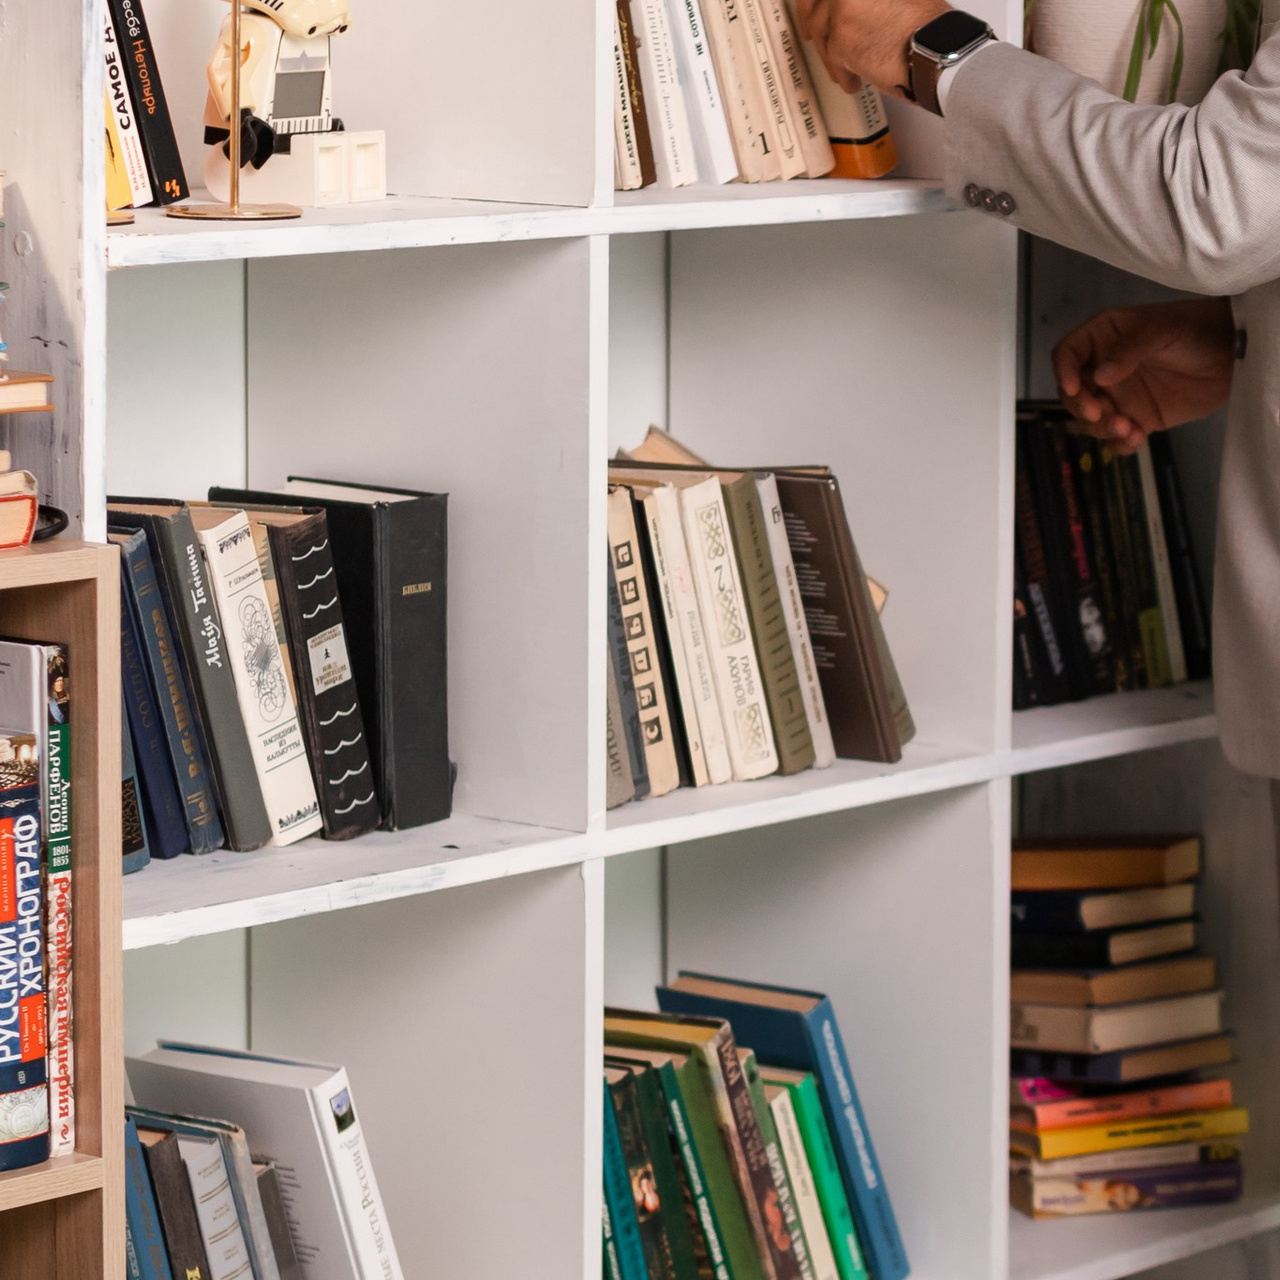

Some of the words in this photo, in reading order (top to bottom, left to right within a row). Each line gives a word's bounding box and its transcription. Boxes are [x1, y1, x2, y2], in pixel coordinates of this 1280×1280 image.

[127, 39, 163, 115] Нетопырь
[694, 42, 704, 55] НЕ
[105, 51, 132, 130] САМОЕ
[778, 29, 804, 90] МЕРТВЫЕ
[798, 98, 818, 139] ДУШИ
[180, 543, 208, 613] Ганина
[196, 613, 226, 670] Майя
[739, 655, 755, 695] ГАРИФ
[727, 655, 746, 707] АХУНОВ
[263, 724, 297, 747] НАСЛЕДНИК
[48, 729, 60, 835] ПАРФЕНОВ
[60, 779, 71, 832] Леонид
[52, 856, 69, 867] 1855
[14, 813, 42, 997] ХРОНОГРАФ
[53, 876, 72, 1010] Российская
[52, 1013, 70, 1119] империя
